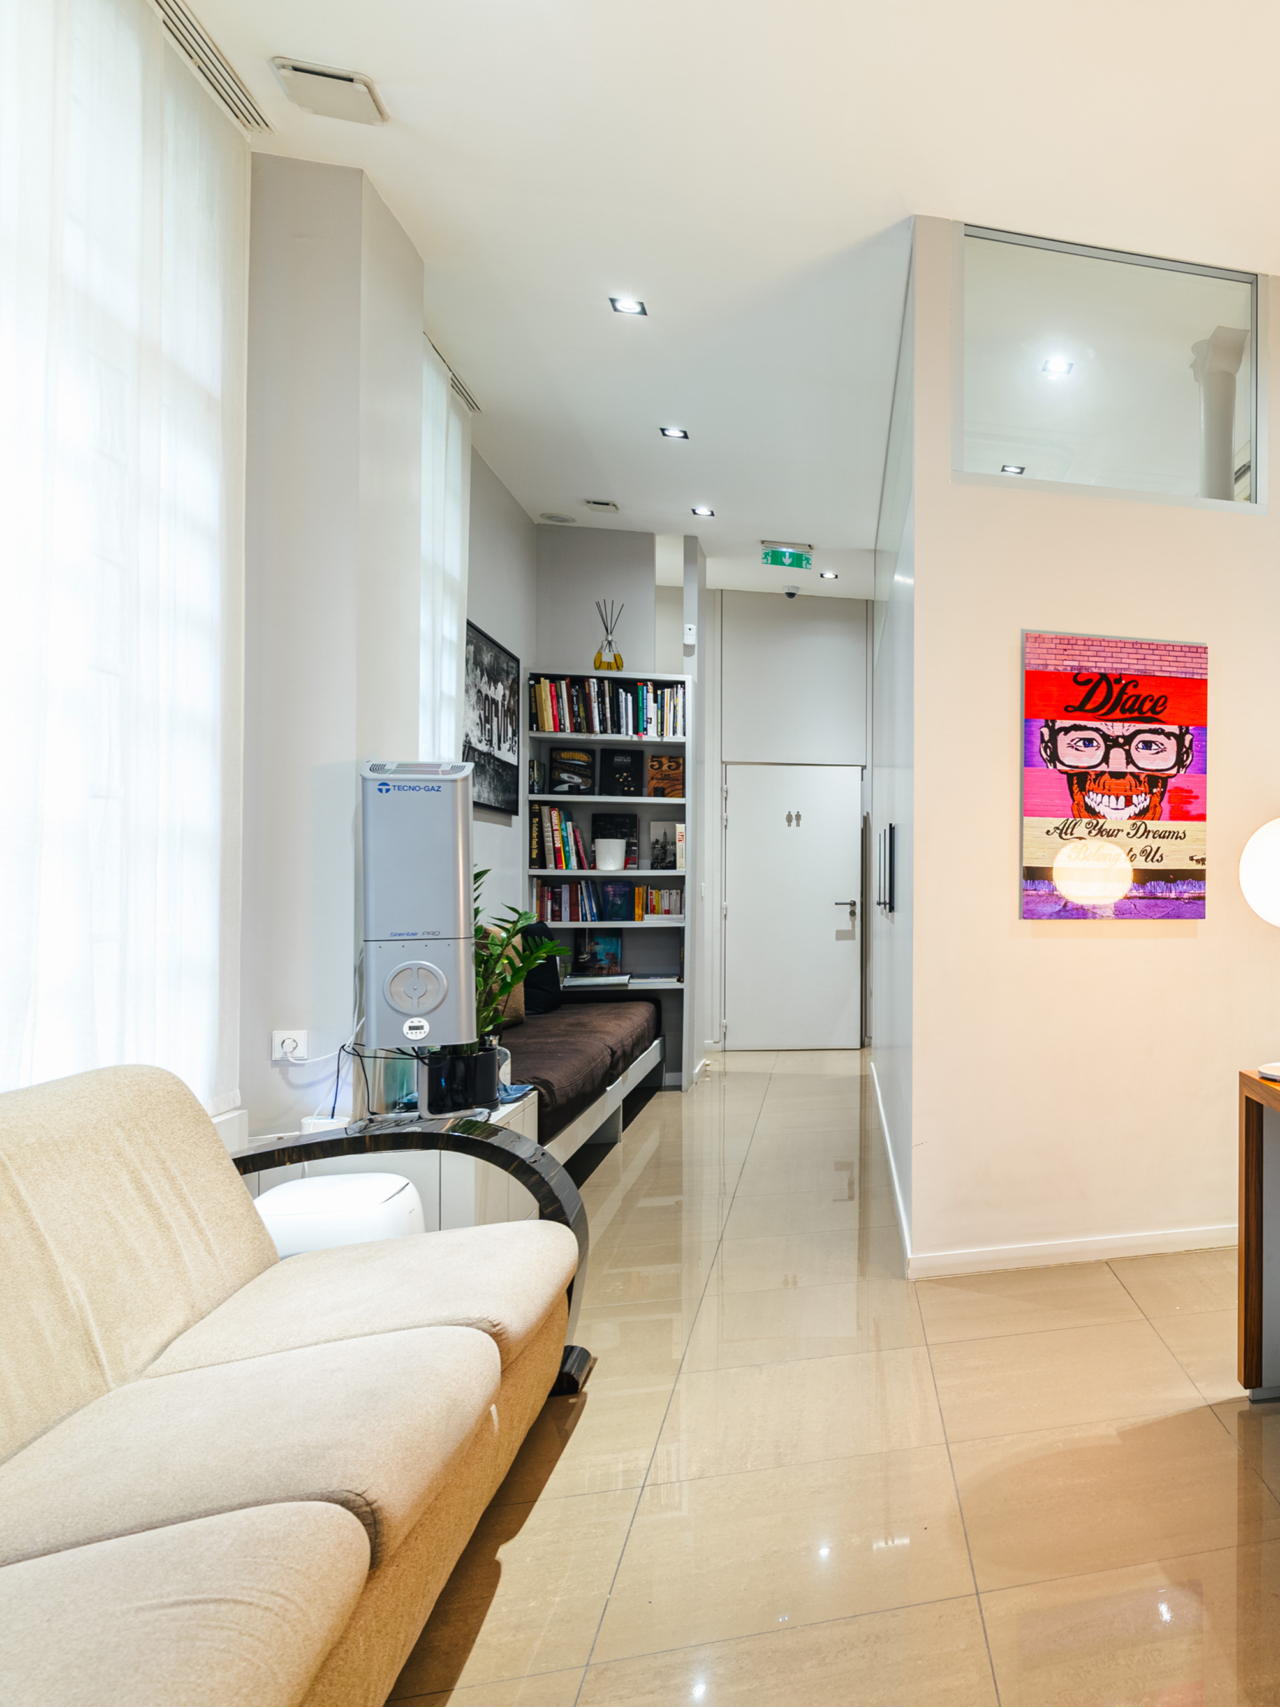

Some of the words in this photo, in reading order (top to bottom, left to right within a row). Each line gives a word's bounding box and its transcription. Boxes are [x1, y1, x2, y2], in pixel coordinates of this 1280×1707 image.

[392, 784, 442, 792] TECNO-GAZ
[1046, 818, 1086, 840] All
[1085, 819, 1124, 838] Your
[1126, 820, 1187, 840] Dreams
[1139, 845, 1164, 863] Us
